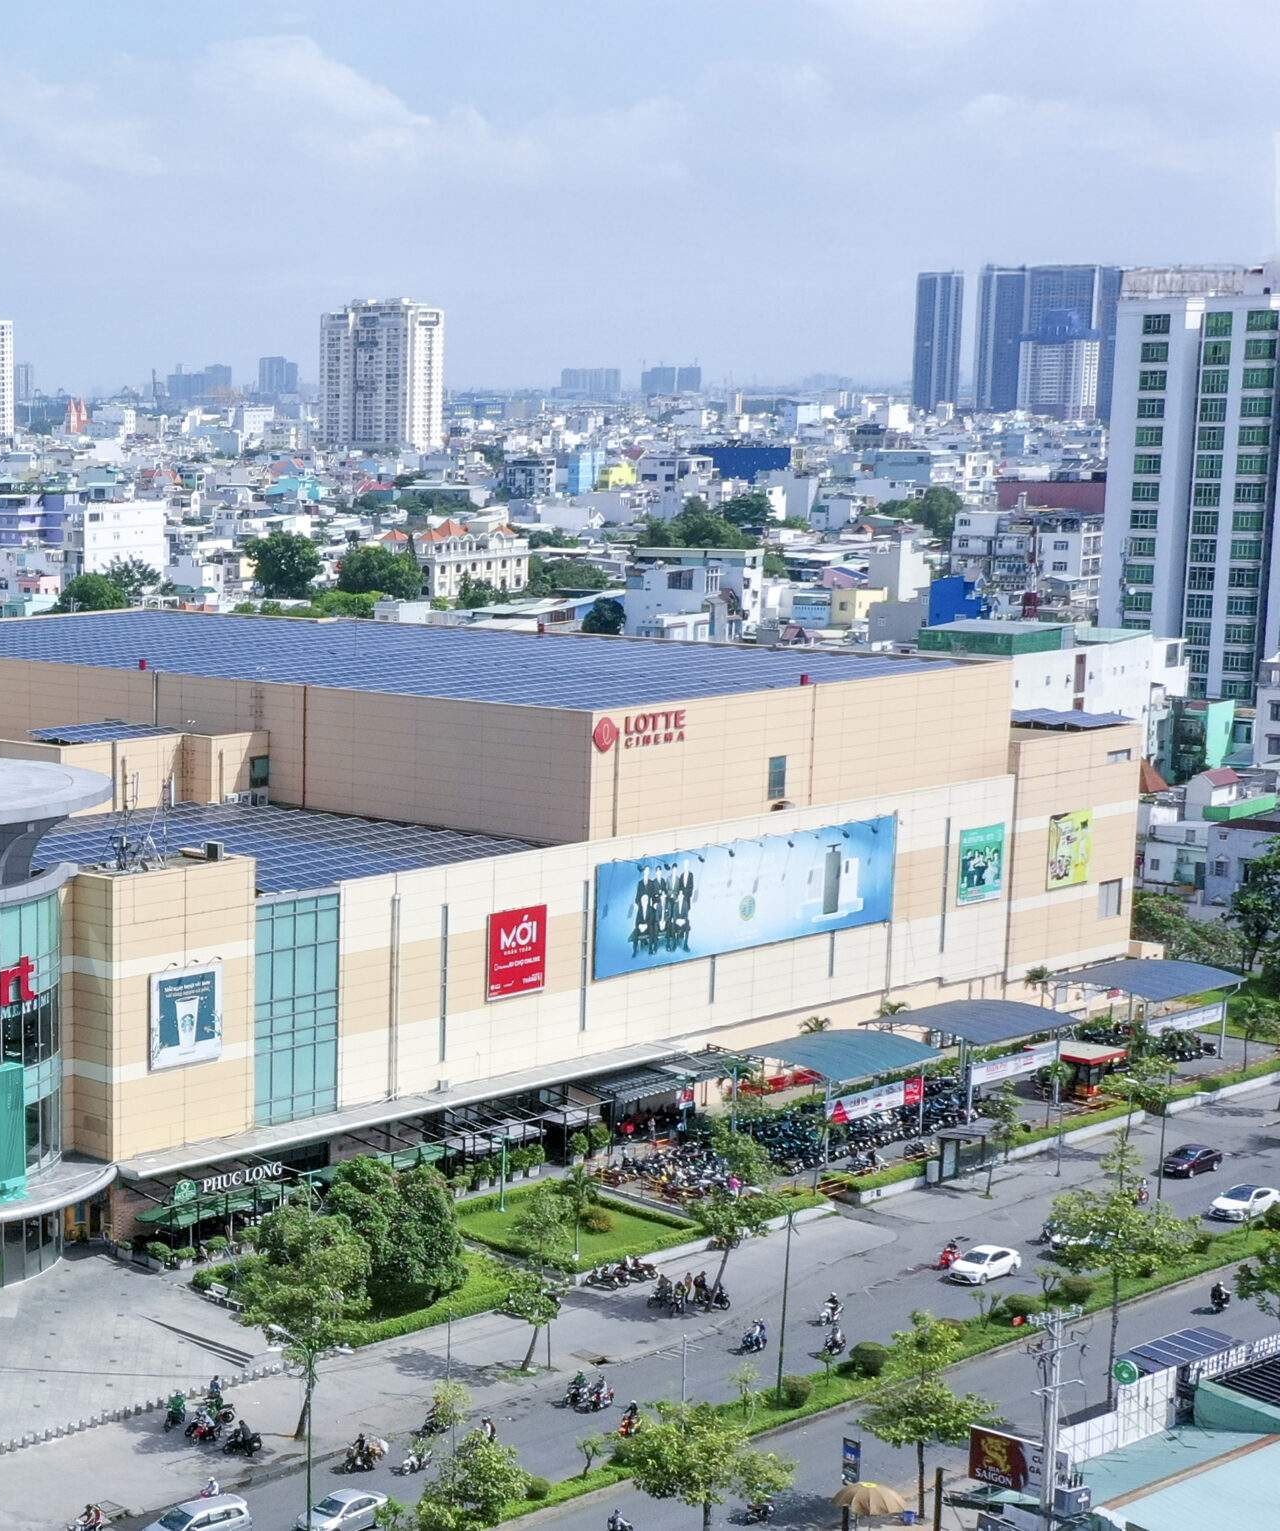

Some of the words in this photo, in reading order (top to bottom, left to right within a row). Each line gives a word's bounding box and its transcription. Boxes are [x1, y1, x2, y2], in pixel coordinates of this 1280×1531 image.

[624, 710, 686, 735] LOTTE
[624, 731, 685, 749] CINEMA
[500, 914, 537, 950] MỚI
[202, 1172, 241, 1193] PHUC
[245, 1161, 282, 1183] LONG
[975, 1467, 1013, 1488] SAIGON
